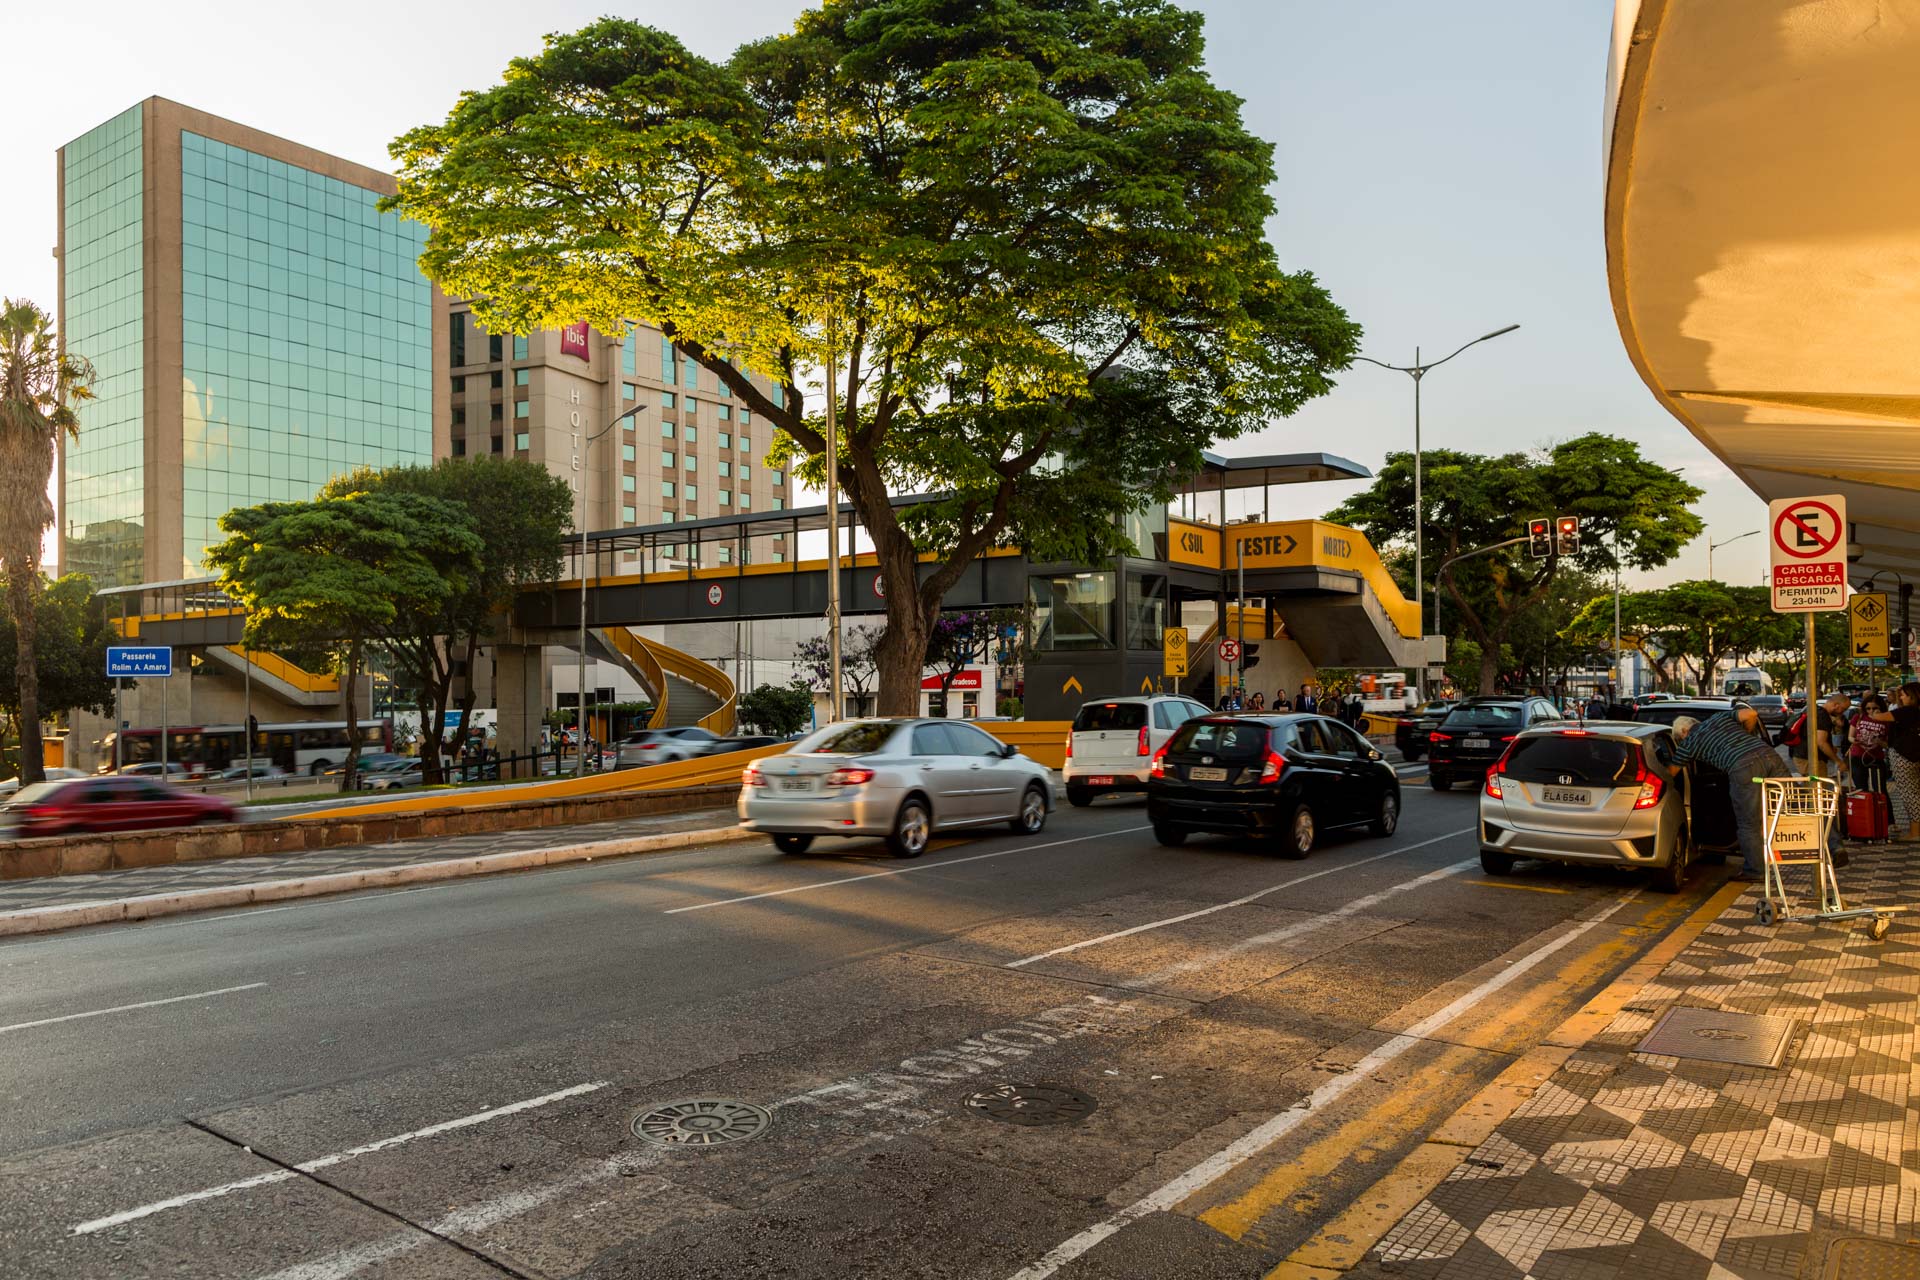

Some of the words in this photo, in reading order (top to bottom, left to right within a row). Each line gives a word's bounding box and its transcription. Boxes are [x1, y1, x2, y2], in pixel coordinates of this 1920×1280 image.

[566, 326, 585, 346] ibis
[571, 388, 580, 493] HOTEL
[1796, 513, 1819, 547] E
[1188, 532, 1204, 554] SUL
[1323, 535, 1346, 558] NORTE
[1781, 565, 1823, 575] CARGA
[1828, 564, 1836, 573] E
[1776, 574, 1841, 585] DESCARGA
[1779, 586, 1838, 597] PERMITIDA
[1792, 597, 1826, 605] 23-04h
[121, 652, 156, 660] Passarela
[1543, 791, 1561, 801] FLA
[1562, 793, 1586, 802] 6544
